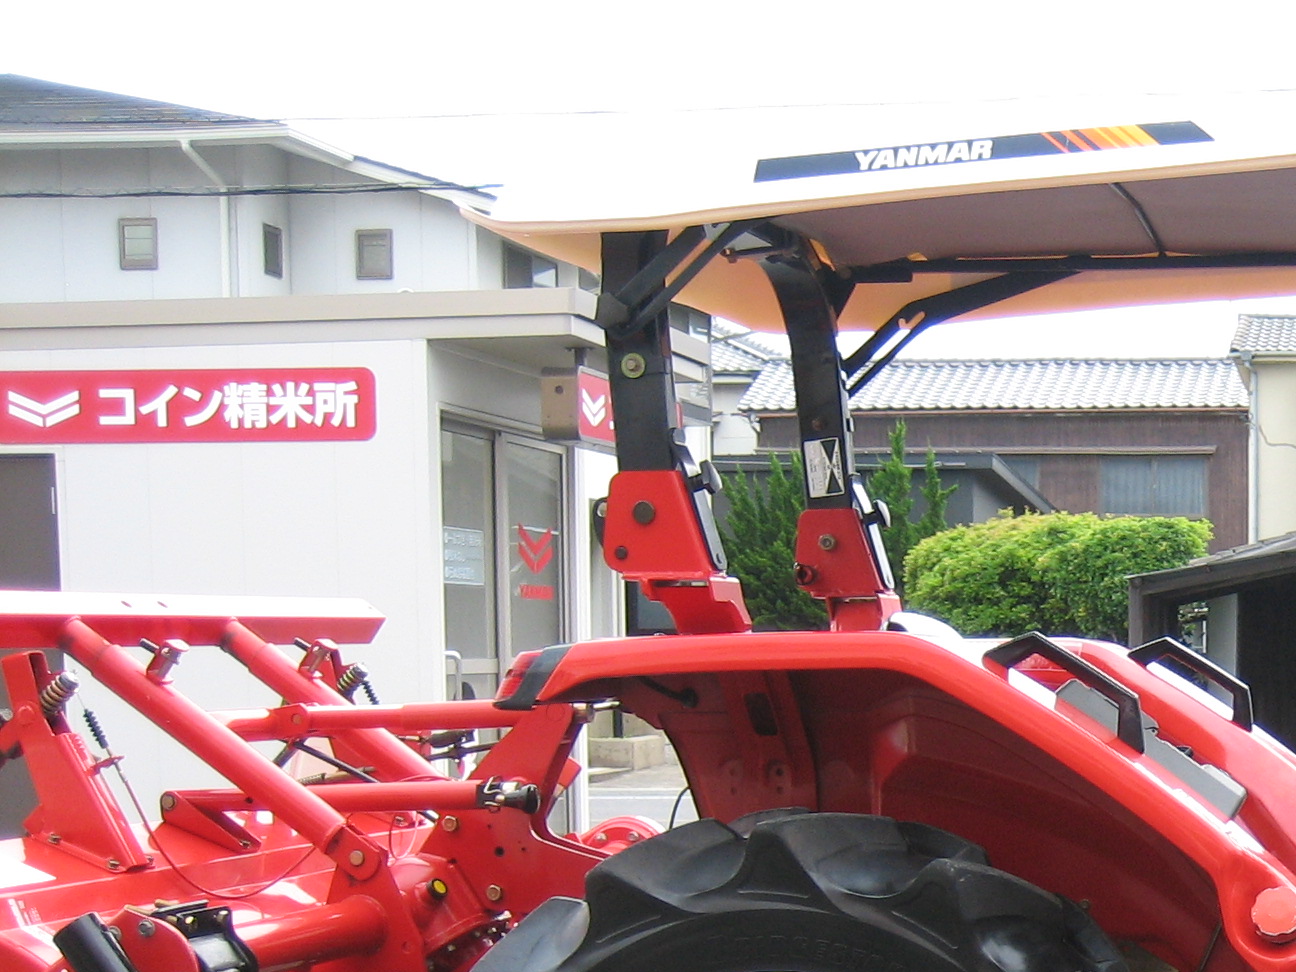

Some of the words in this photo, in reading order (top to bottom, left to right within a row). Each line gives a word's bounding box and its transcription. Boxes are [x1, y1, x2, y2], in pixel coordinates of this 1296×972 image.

[853, 139, 994, 171] YANMAR
[97, 380, 359, 429] コイン精米所
